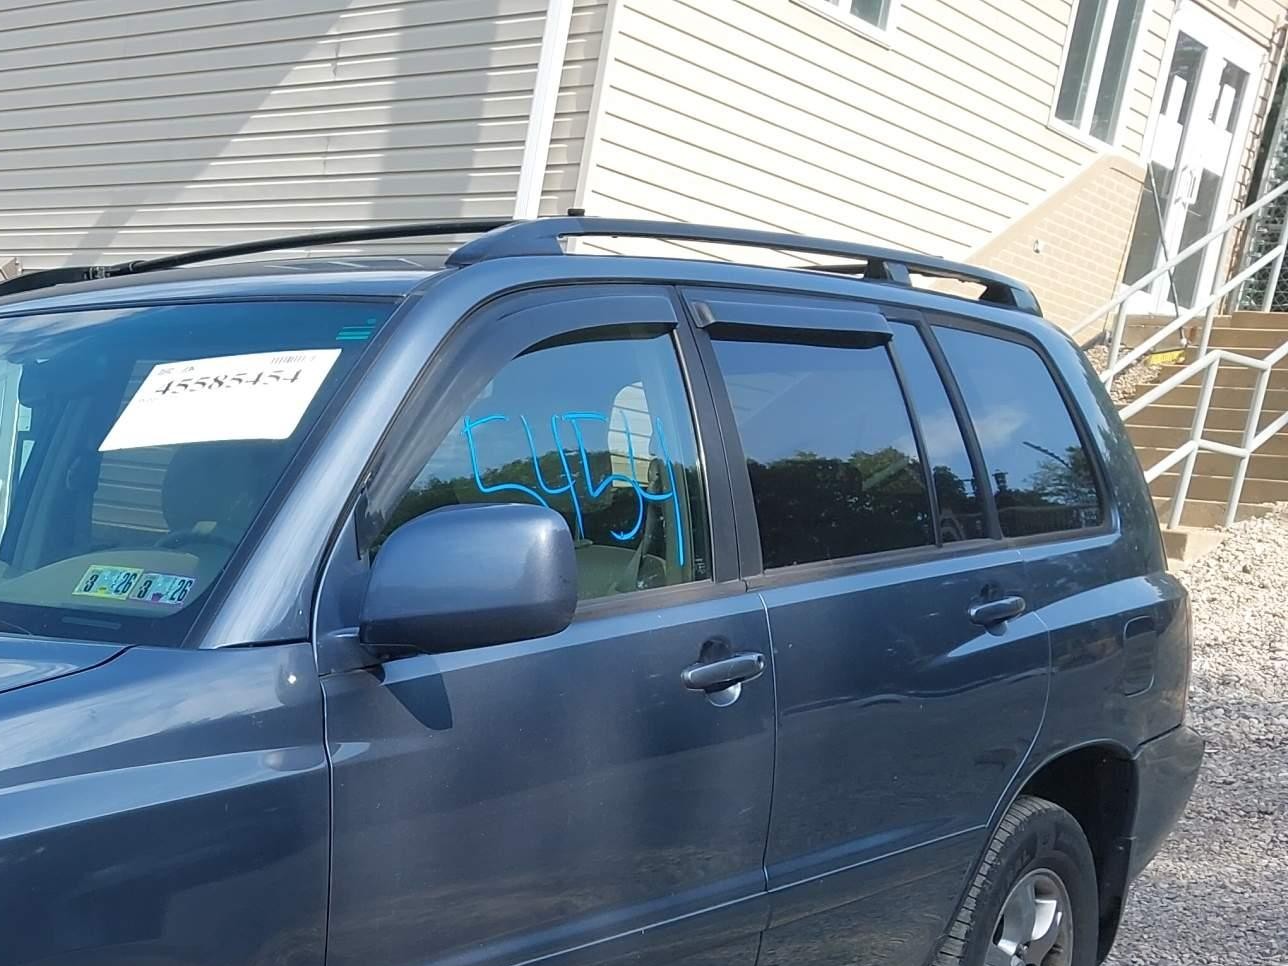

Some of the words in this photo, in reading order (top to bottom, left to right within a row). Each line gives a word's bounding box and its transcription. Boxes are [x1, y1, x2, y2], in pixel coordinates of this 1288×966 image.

[155, 368, 303, 395] 45585454
[113, 572, 138, 594] 26
[169, 578, 193, 601] 26
